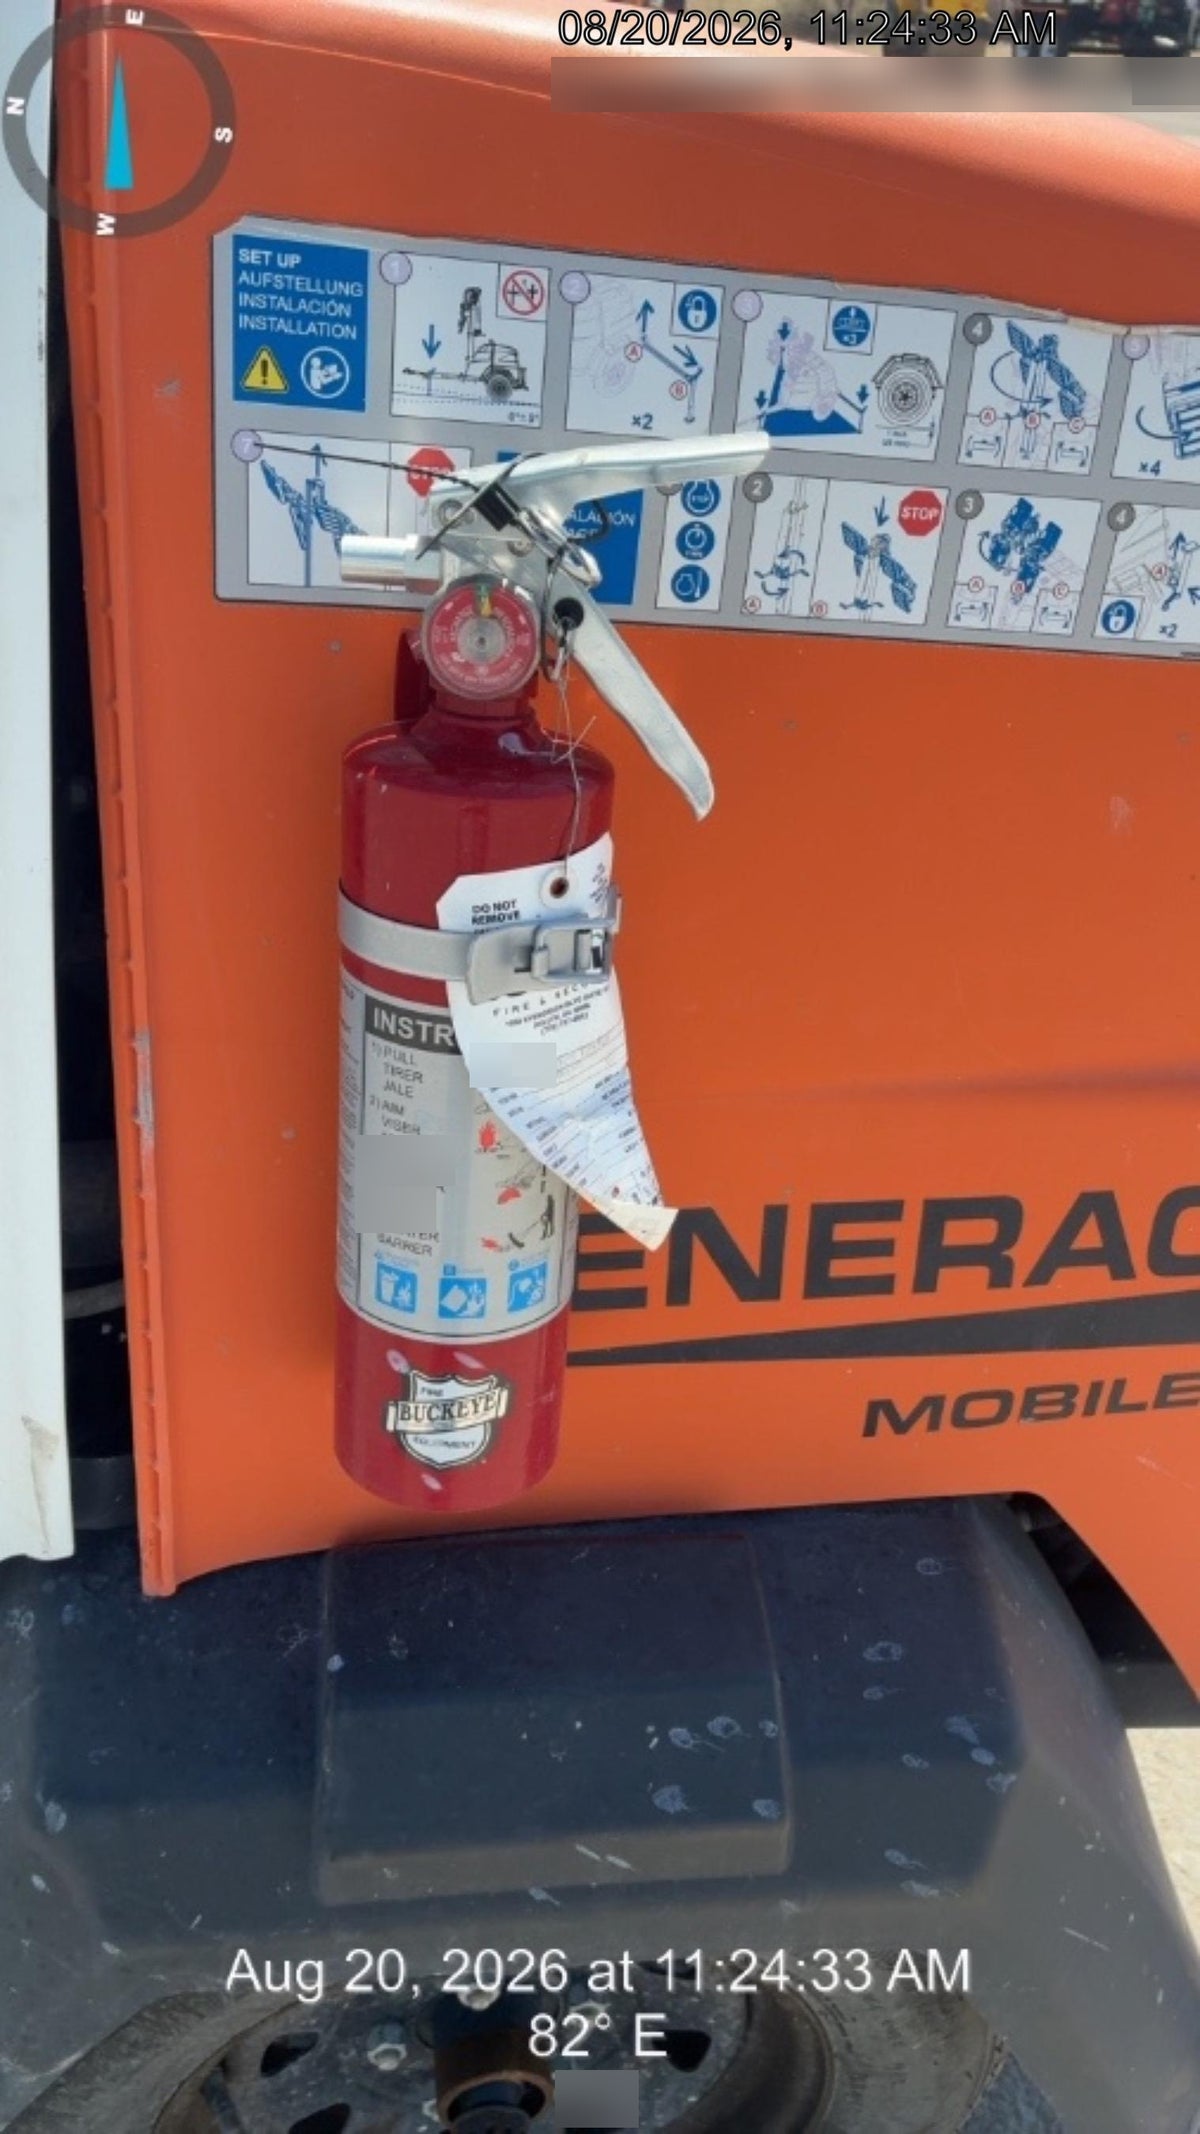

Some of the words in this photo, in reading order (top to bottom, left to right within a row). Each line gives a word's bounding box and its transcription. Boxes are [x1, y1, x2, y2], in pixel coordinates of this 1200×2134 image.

[238, 249, 272, 267] SET
[277, 253, 302, 268] UP
[238, 271, 364, 297] AUFSTELLUNG
[238, 292, 352, 317] INSTALACIÓN
[238, 314, 357, 340] INSTALLATION
[972, 322, 982, 336] 4
[752, 481, 763, 496] 2
[964, 497, 974, 512] 3
[901, 507, 939, 520] STOP
[1116, 510, 1127, 524] 4
[472, 904, 490, 914] DO
[493, 901, 517, 912] NOT
[471, 910, 520, 925] REMOVE
[383, 1044, 418, 1066] PULL
[383, 1062, 424, 1084] TIRER
[381, 1100, 405, 1116] AIM
[400, 1391, 497, 1422] BUCKEYE
